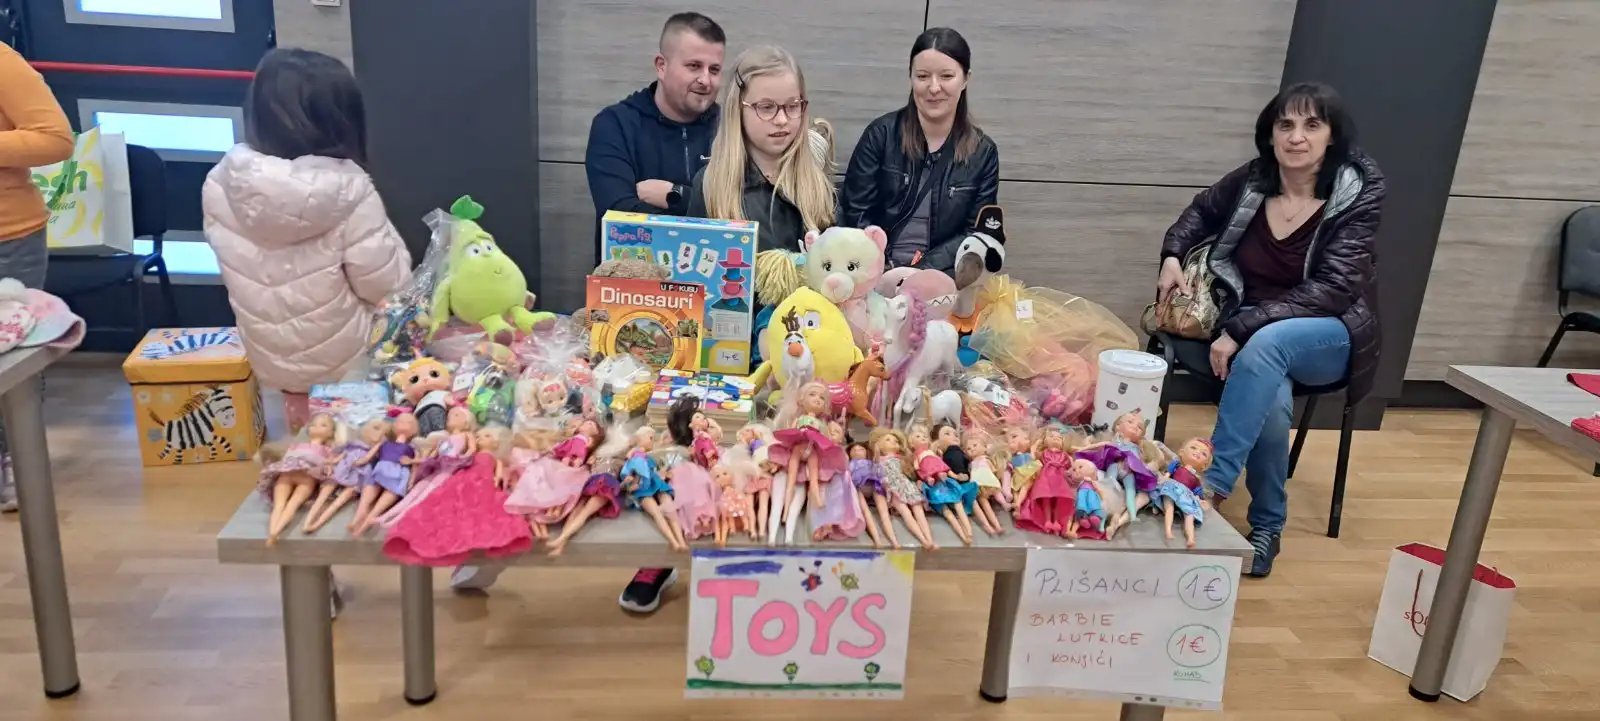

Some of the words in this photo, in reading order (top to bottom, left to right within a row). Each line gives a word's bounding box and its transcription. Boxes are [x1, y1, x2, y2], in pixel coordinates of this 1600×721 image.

[601, 286, 693, 309] Dinosauri
[1035, 568, 1160, 597] PLIŠANCI
[1185, 573, 1223, 602] 1€
[1030, 613, 1114, 626] BARBIE
[1176, 634, 1206, 654] 1€
